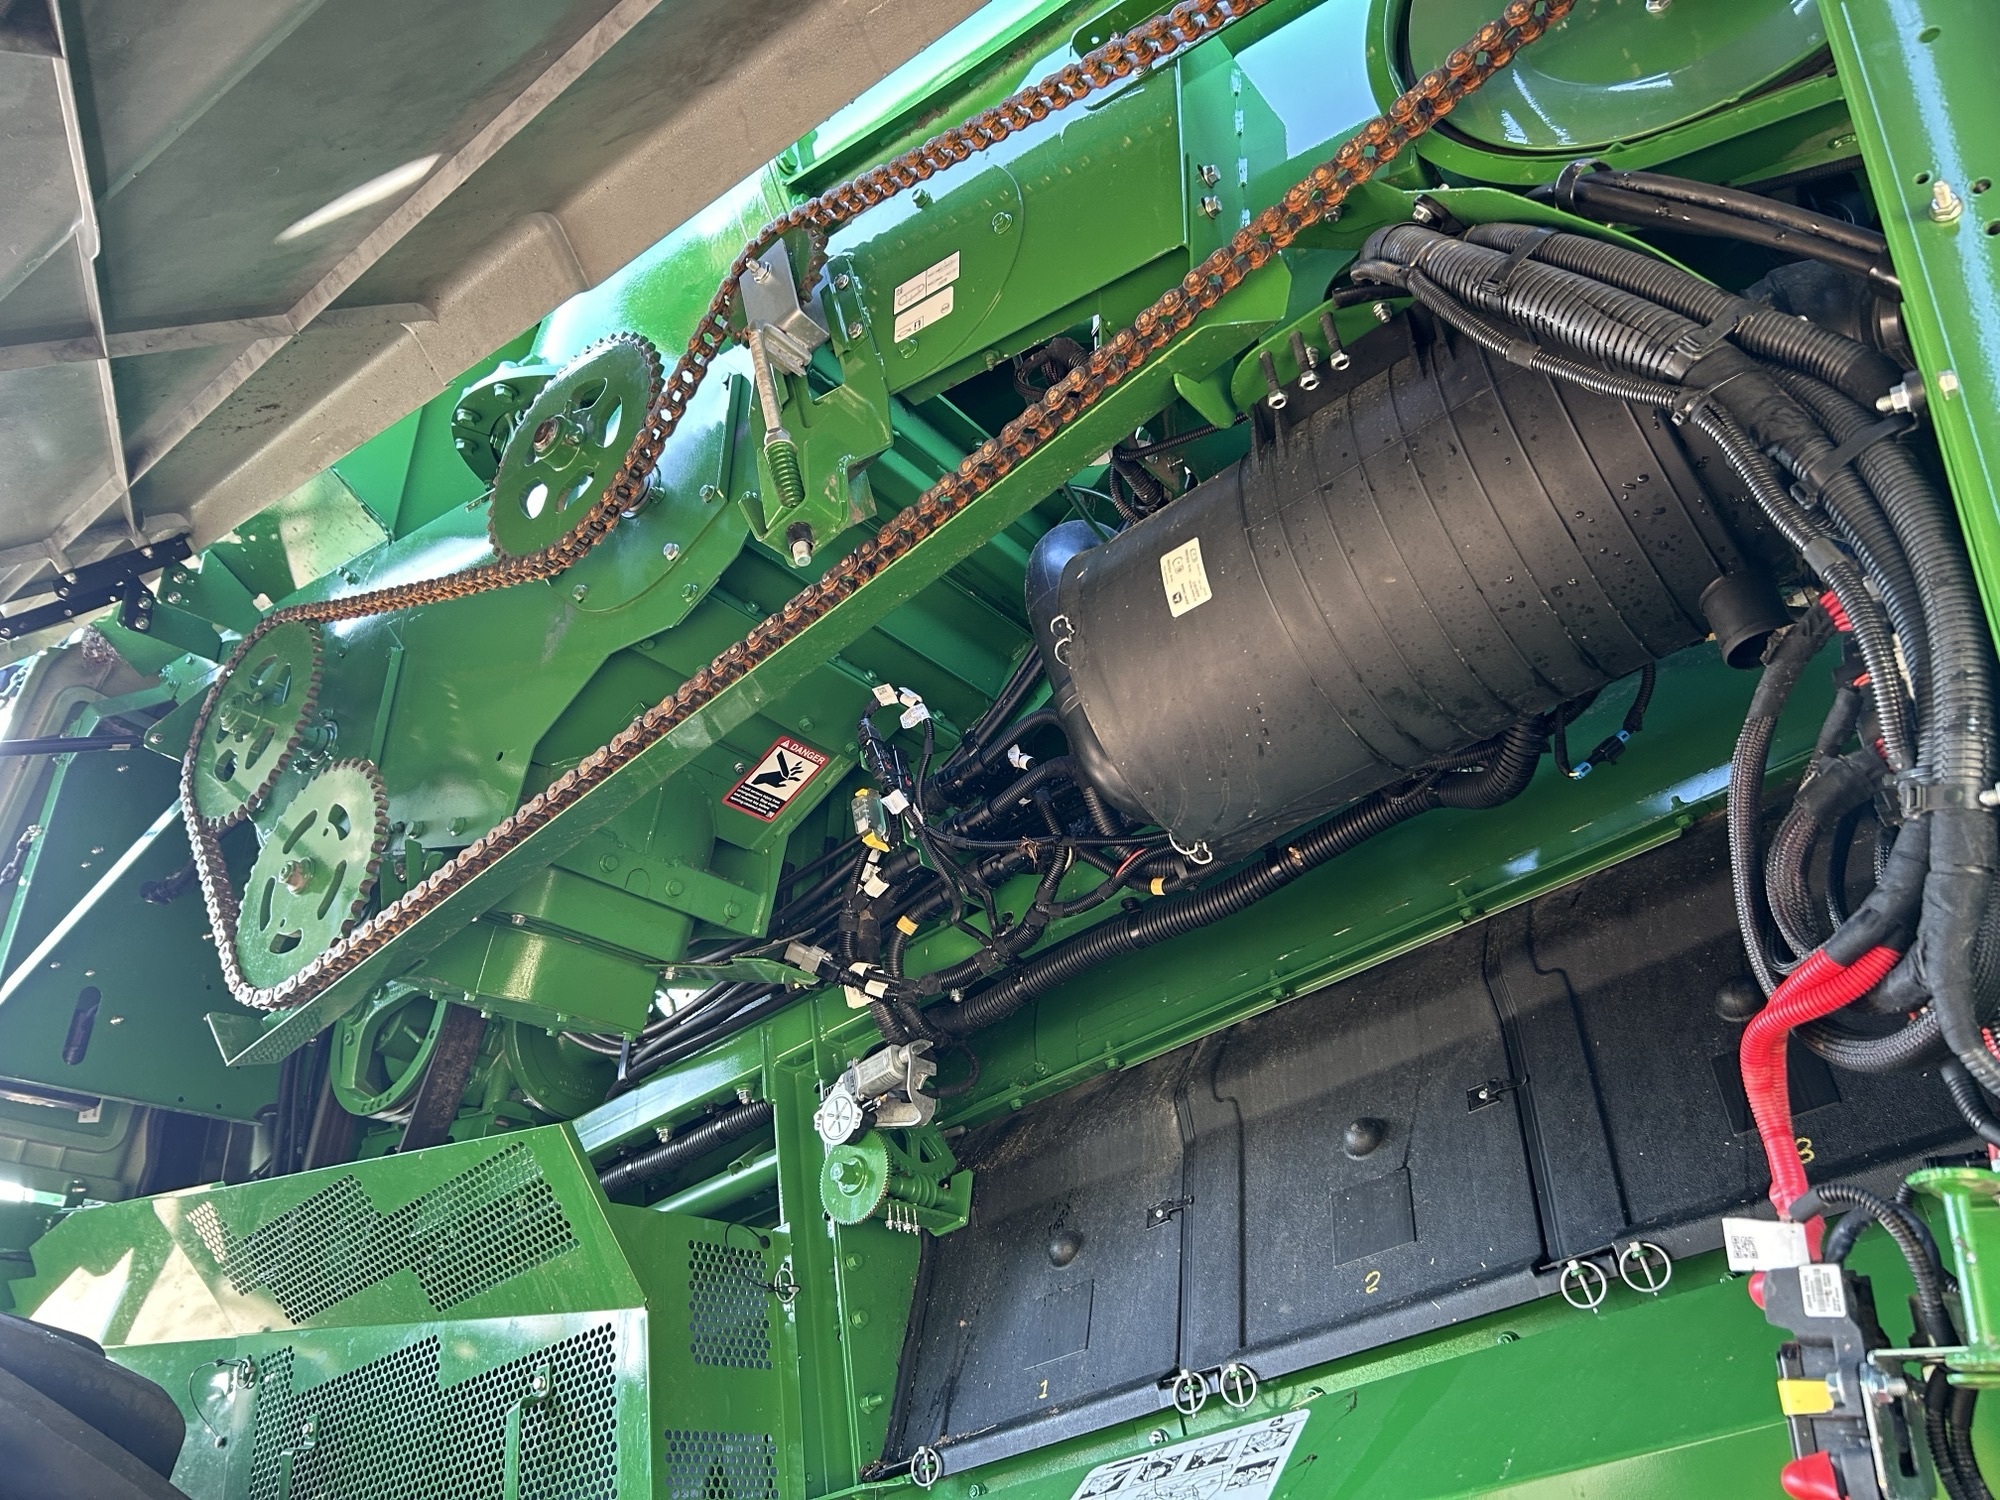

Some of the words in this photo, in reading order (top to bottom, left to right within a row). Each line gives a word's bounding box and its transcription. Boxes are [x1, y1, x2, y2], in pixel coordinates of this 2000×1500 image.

[790, 743, 825, 764] DANGER
[1795, 1137, 1815, 1164] 3
[1365, 1270, 1381, 1294] 2
[1038, 1379, 1048, 1399] 1
